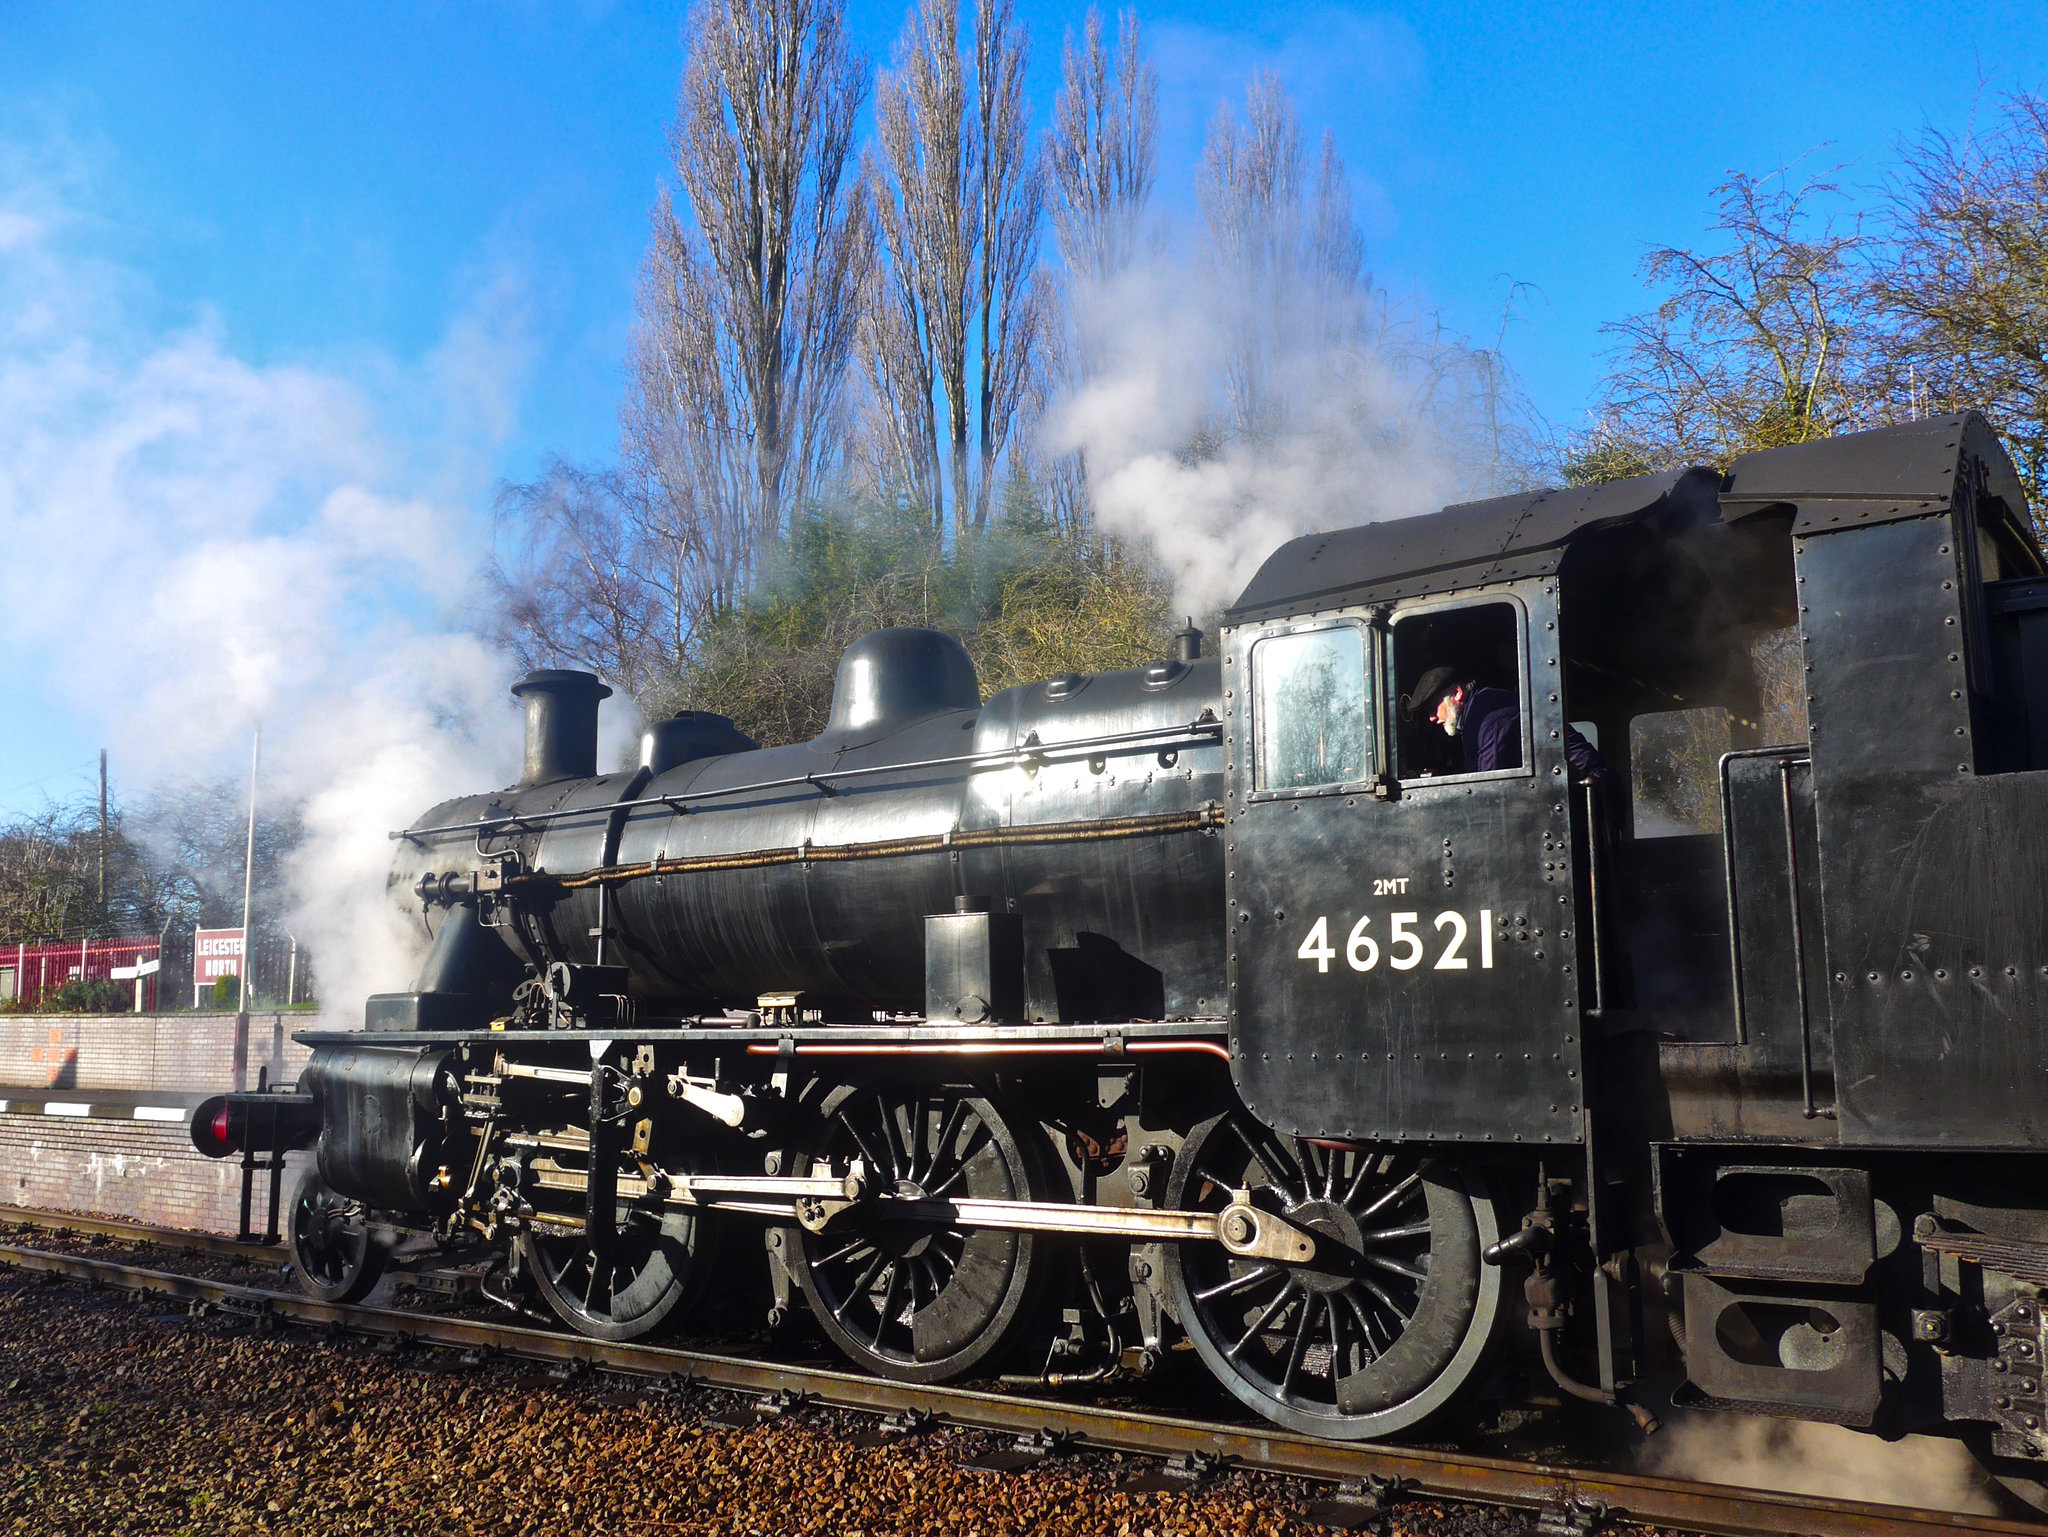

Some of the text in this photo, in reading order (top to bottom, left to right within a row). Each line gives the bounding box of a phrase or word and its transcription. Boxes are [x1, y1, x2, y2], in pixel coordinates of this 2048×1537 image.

[1373, 878, 1409, 896] 2MT
[1297, 909, 1494, 973] 46521
[205, 959, 237, 977] NORTH
